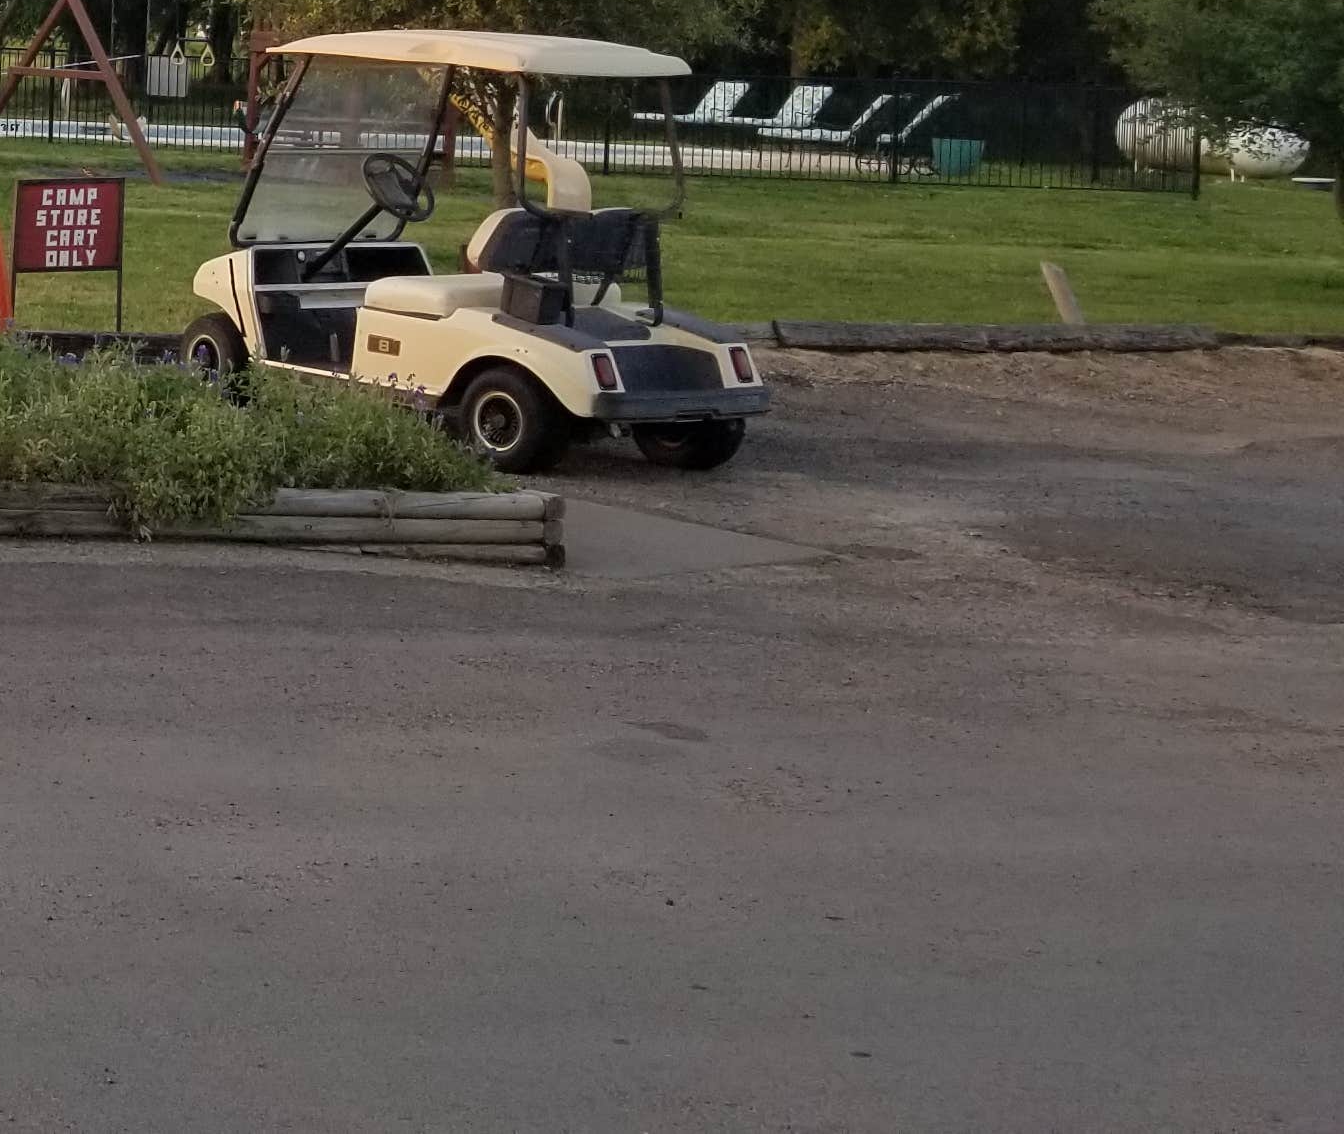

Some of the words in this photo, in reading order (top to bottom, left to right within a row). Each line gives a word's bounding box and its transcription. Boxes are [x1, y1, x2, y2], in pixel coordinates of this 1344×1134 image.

[42, 188, 98, 206] CAMP
[36, 209, 101, 227] STORE
[46, 229, 98, 247] CART
[45, 249, 96, 267] ONLY
